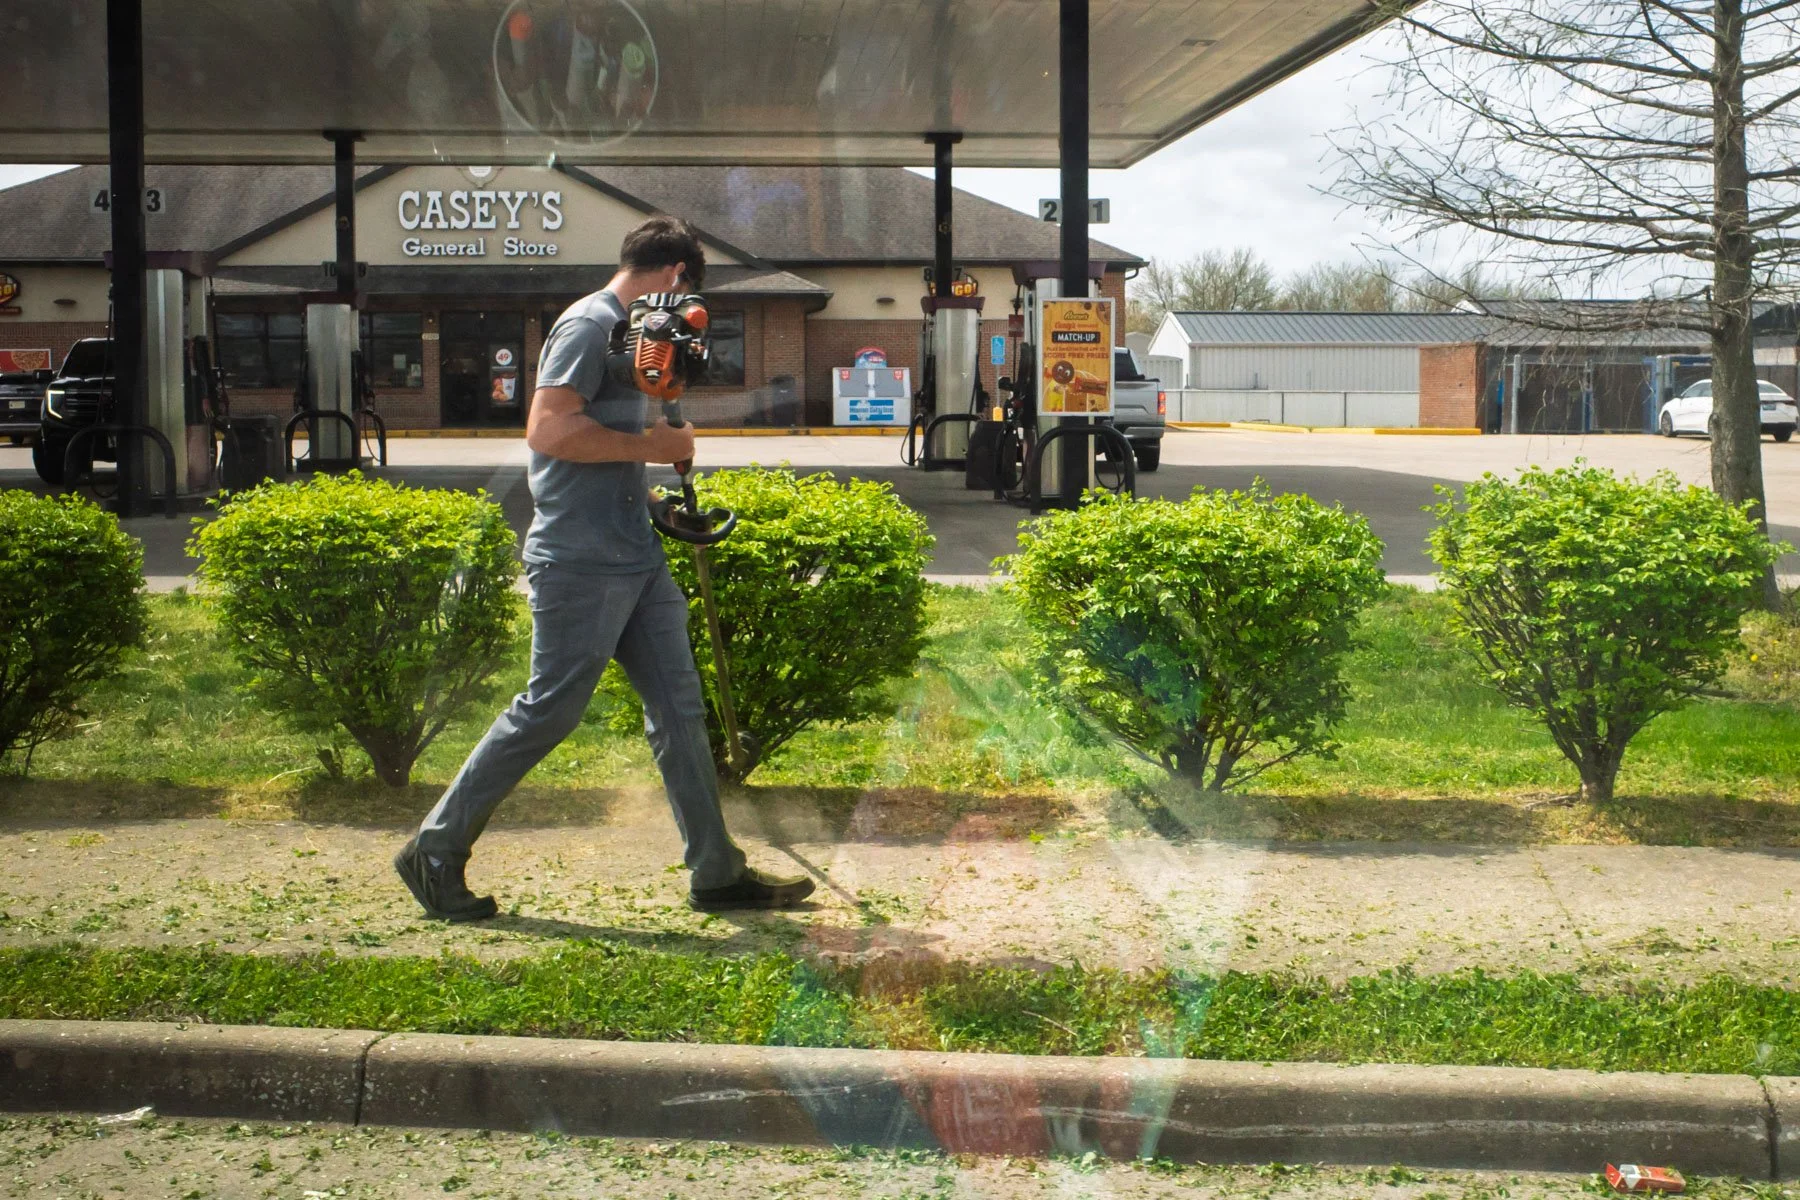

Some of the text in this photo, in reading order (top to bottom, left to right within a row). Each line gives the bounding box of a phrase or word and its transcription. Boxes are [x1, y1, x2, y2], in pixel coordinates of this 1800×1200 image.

[94, 189, 110, 211] 4
[146, 189, 161, 212] 3
[398, 190, 563, 230] CASEY'S
[1043, 200, 1058, 222] 2
[1092, 200, 1103, 222] 1
[402, 236, 558, 256] General Store
[923, 267, 932, 282] 8
[1057, 333, 1096, 342] MATCH-UP
